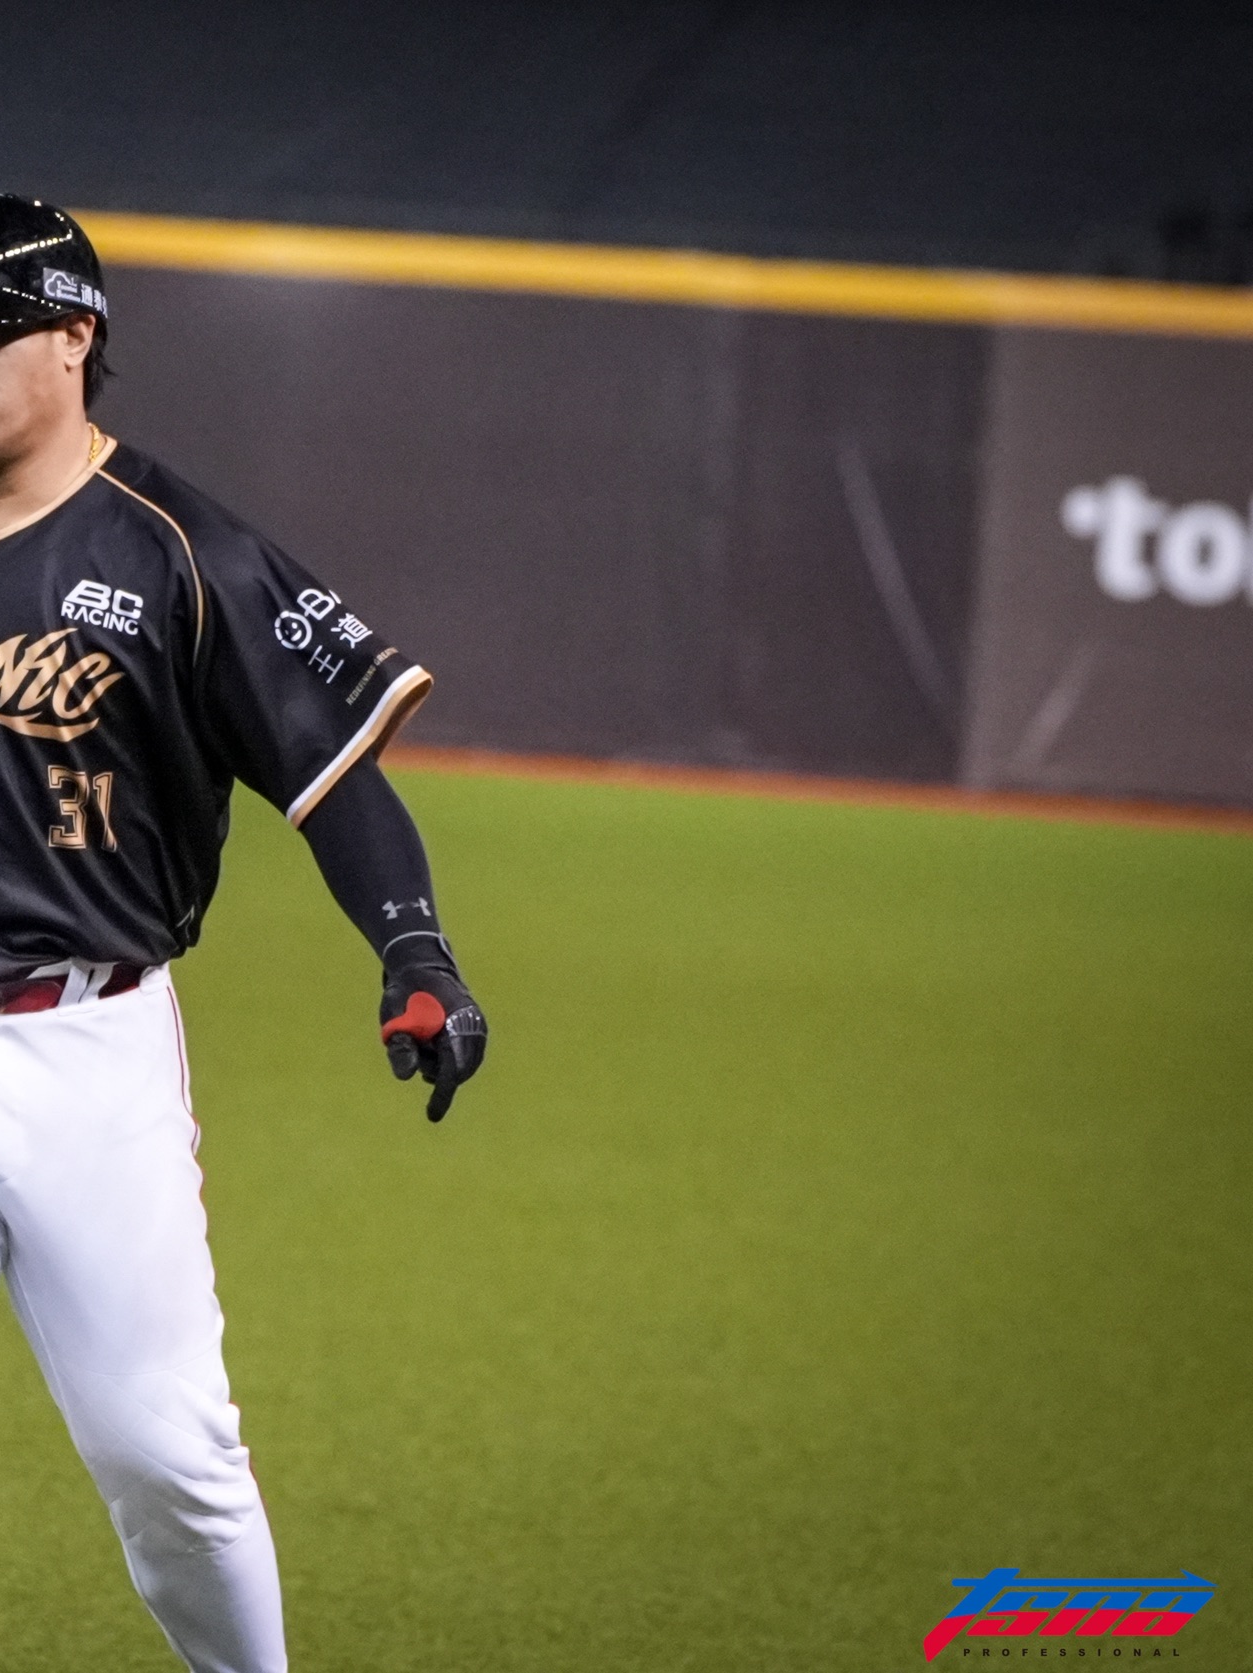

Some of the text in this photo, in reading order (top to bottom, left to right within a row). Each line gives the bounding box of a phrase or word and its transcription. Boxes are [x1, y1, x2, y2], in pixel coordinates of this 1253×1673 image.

[1061, 475, 1253, 607] to
[60, 601, 139, 636] RACING
[63, 579, 144, 621] BC
[47, 764, 118, 852] 31
